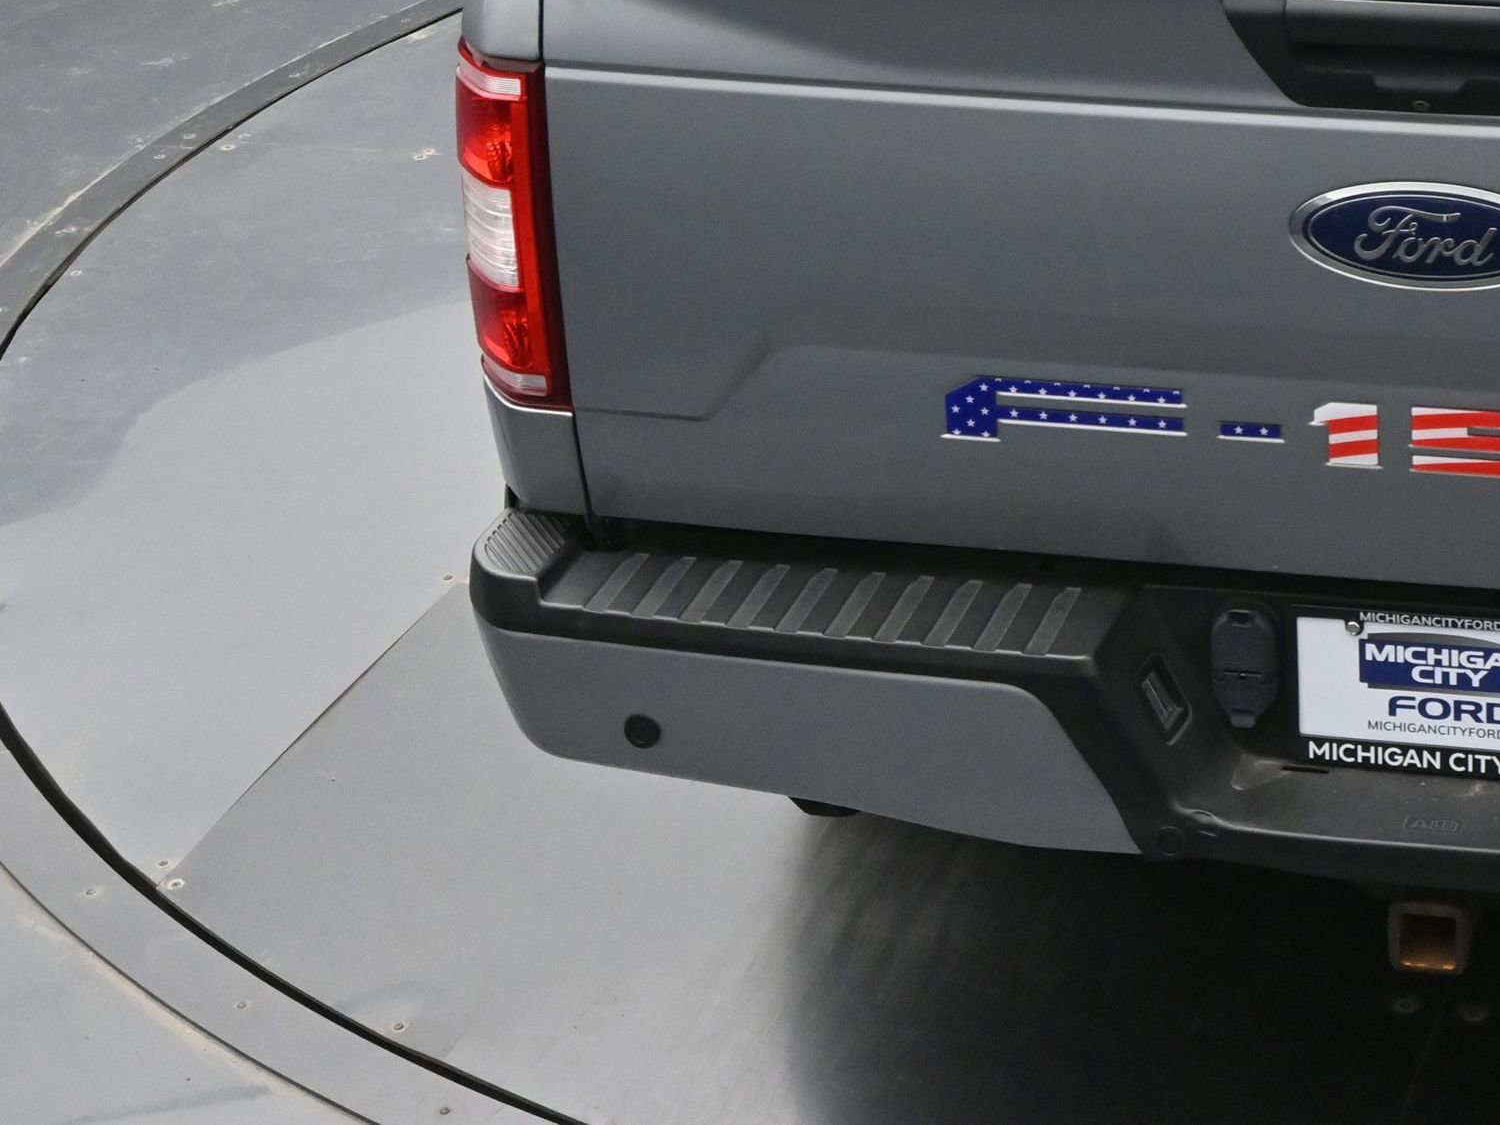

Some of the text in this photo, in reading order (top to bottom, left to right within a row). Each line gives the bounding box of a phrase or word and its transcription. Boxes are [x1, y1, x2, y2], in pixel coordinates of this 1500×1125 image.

[1353, 205, 1498, 267] Ford
[1411, 665, 1489, 688] CITY
[1308, 740, 1441, 770] MICHIGAN
